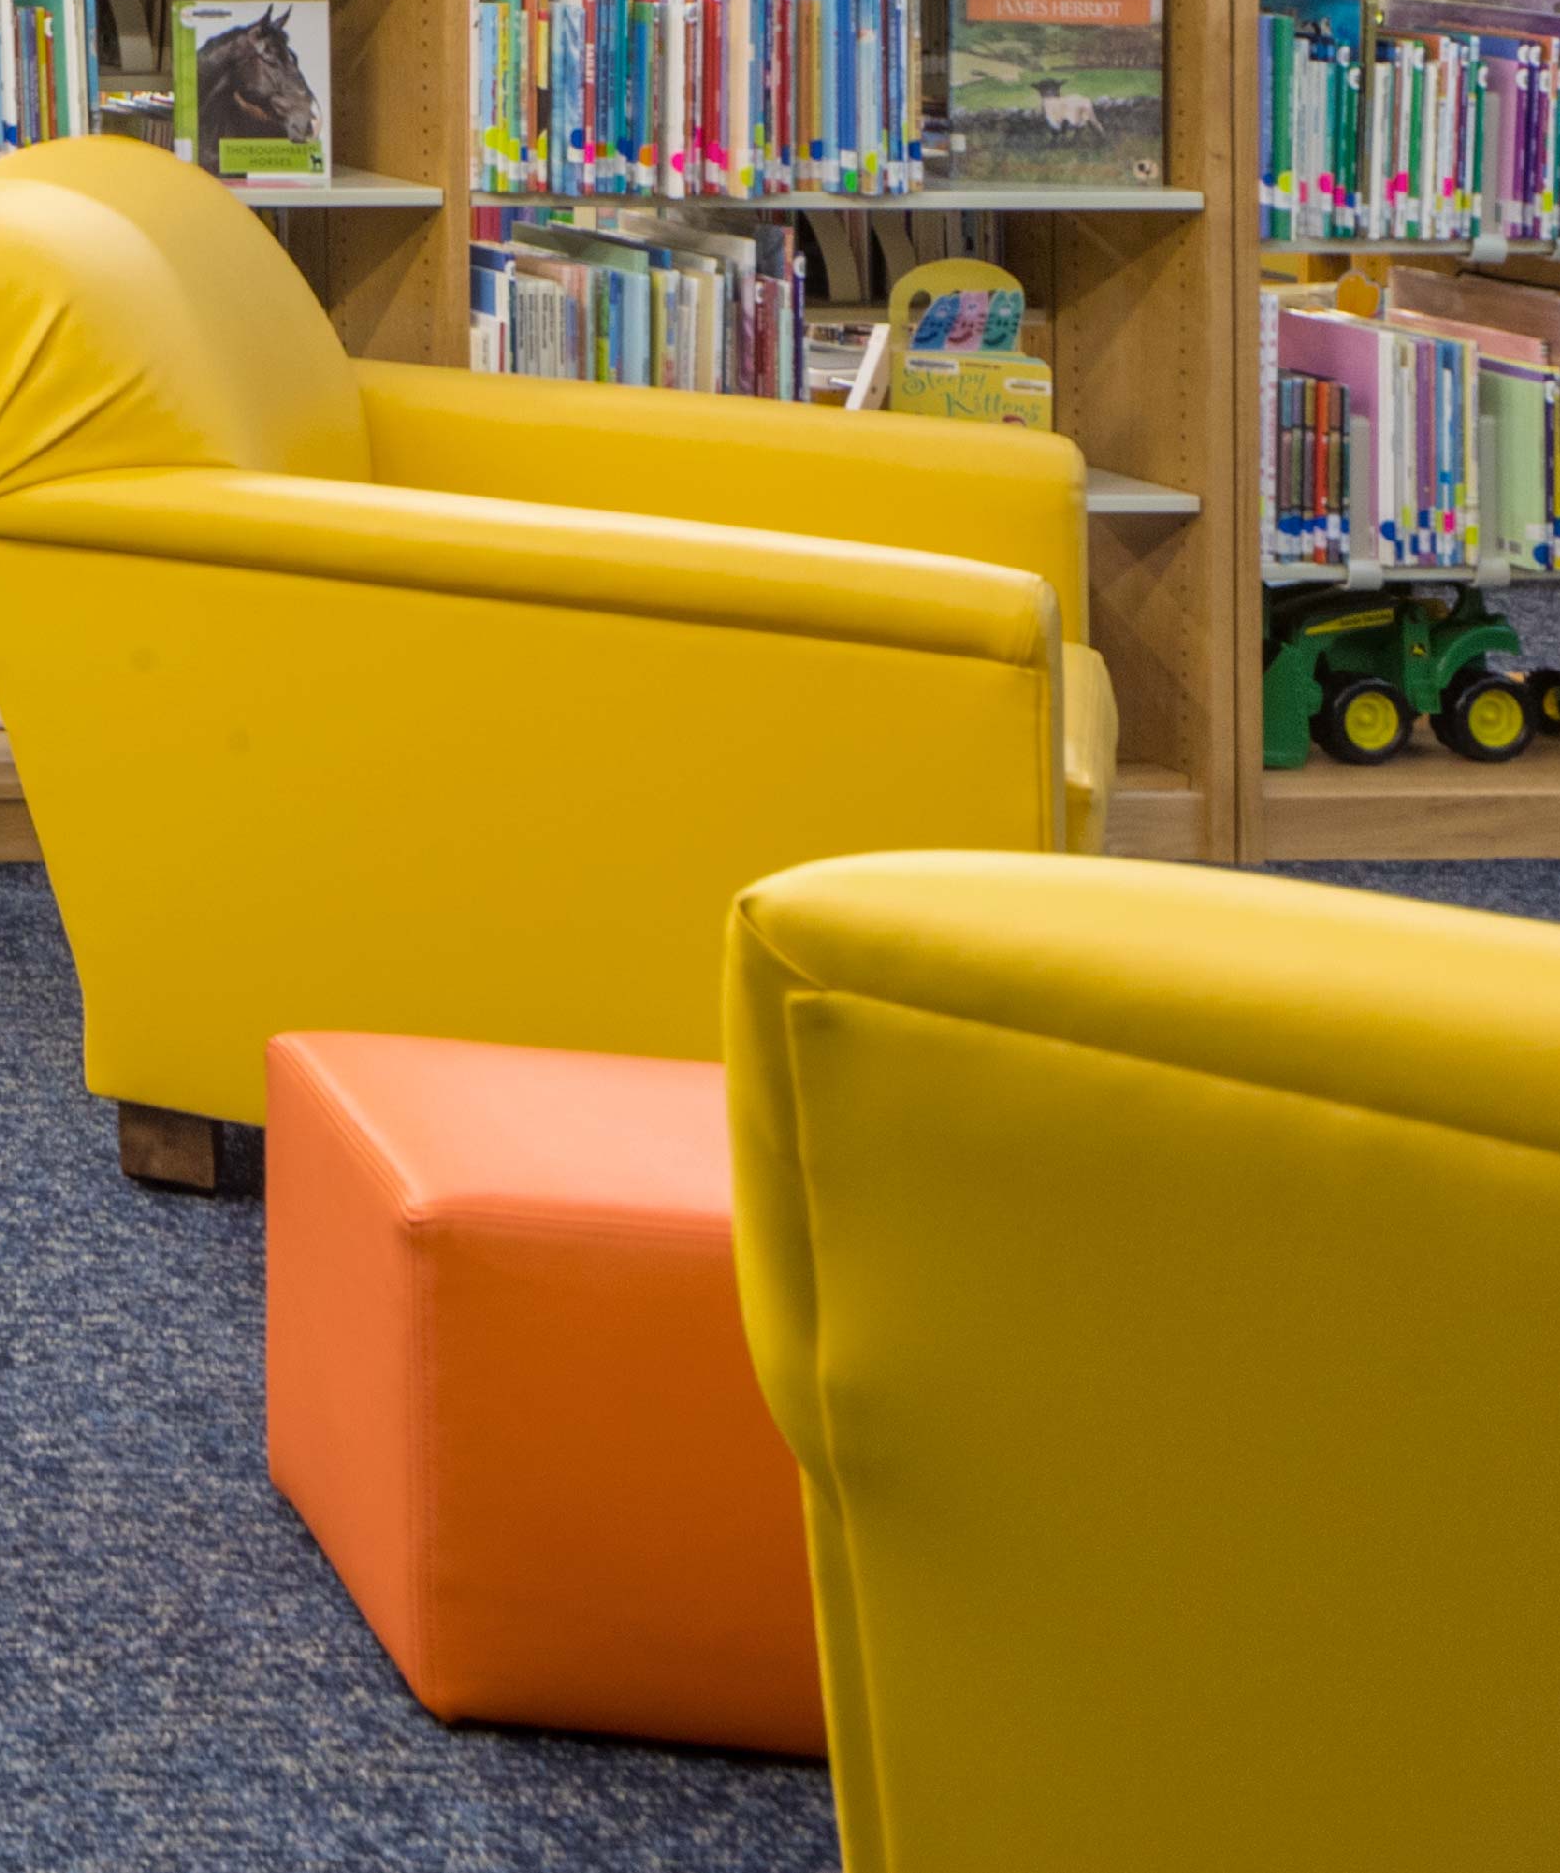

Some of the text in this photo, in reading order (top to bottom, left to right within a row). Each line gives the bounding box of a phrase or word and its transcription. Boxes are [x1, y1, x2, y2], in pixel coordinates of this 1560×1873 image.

[996, 0, 1123, 18] JAMES HERRIOT
[945, 392, 1042, 422] Kittens
